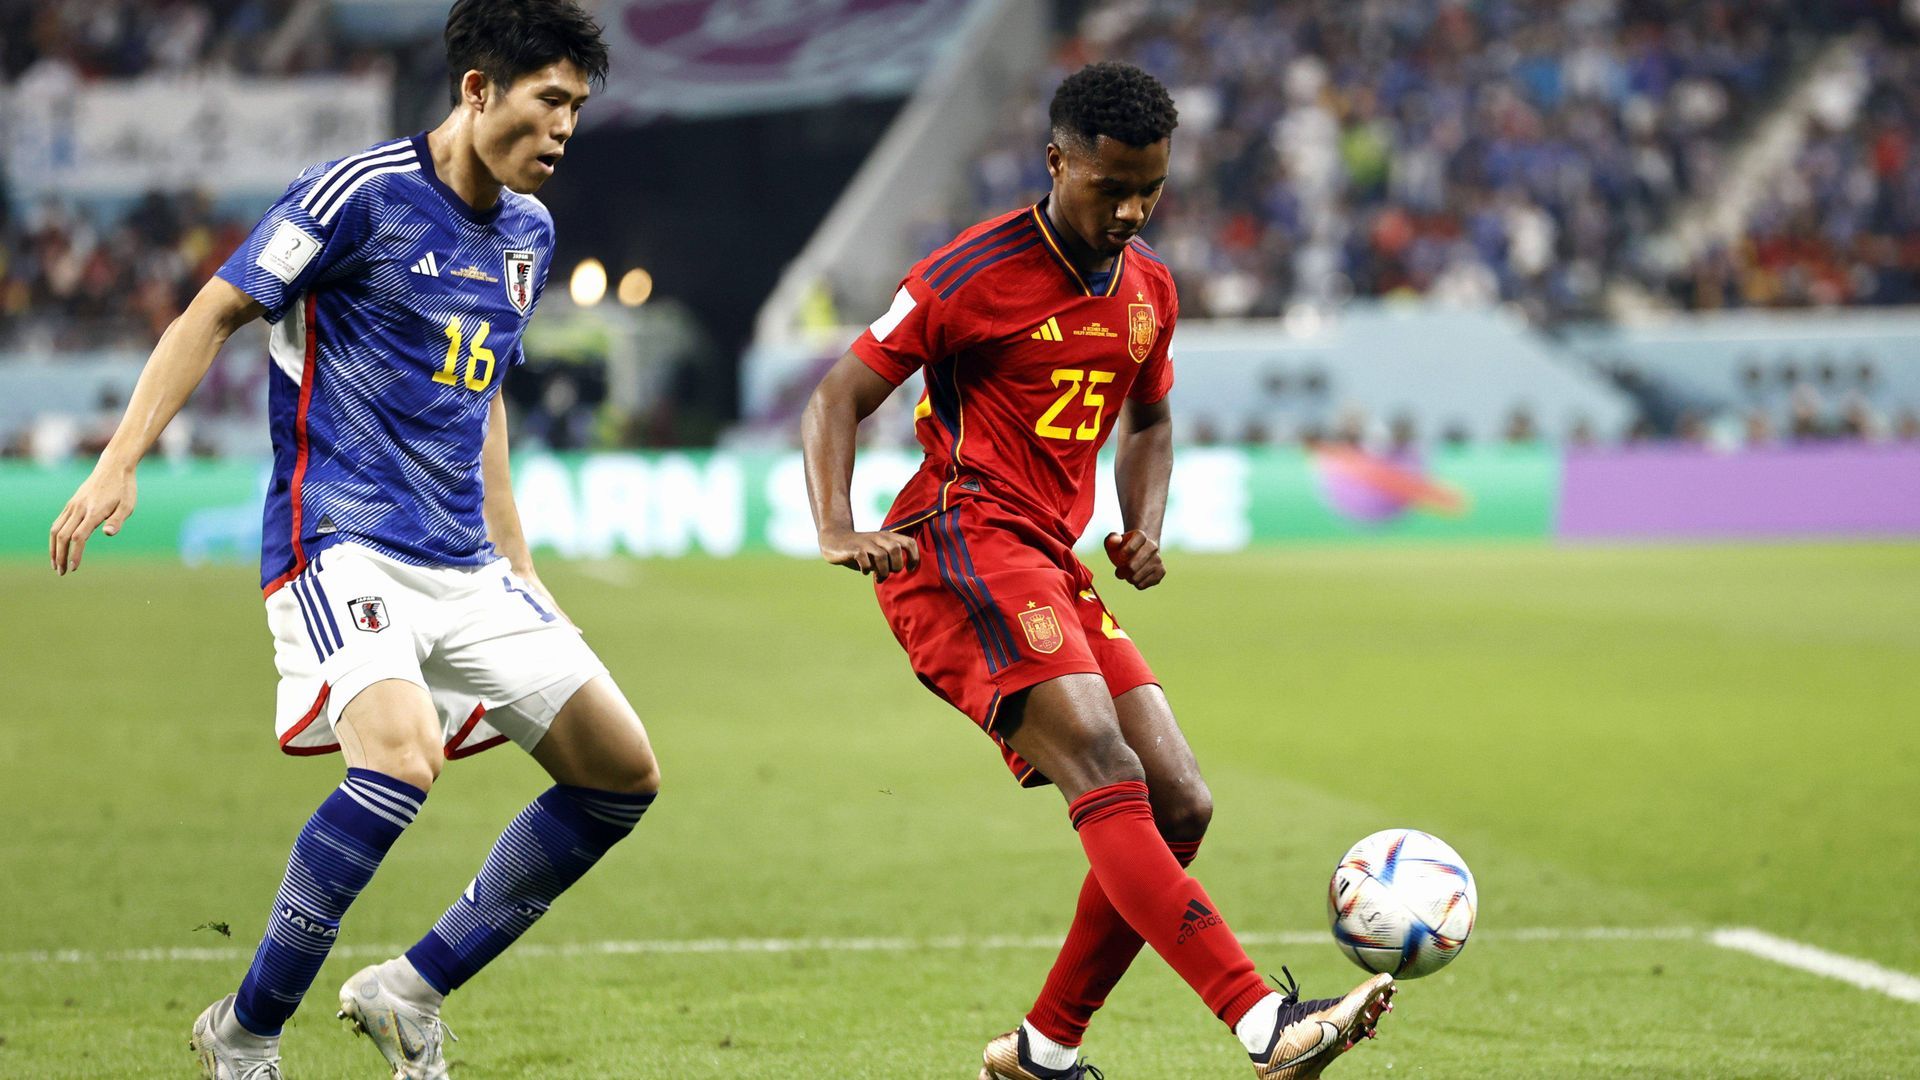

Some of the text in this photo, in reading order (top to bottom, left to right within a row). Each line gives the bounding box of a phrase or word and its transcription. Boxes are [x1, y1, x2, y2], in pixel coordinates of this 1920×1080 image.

[431, 315, 496, 392] 16
[1034, 368, 1116, 441] 25
[513, 451, 746, 559] ARN
[281, 908, 340, 937] JAPA
[1177, 915, 1223, 945] adidas
